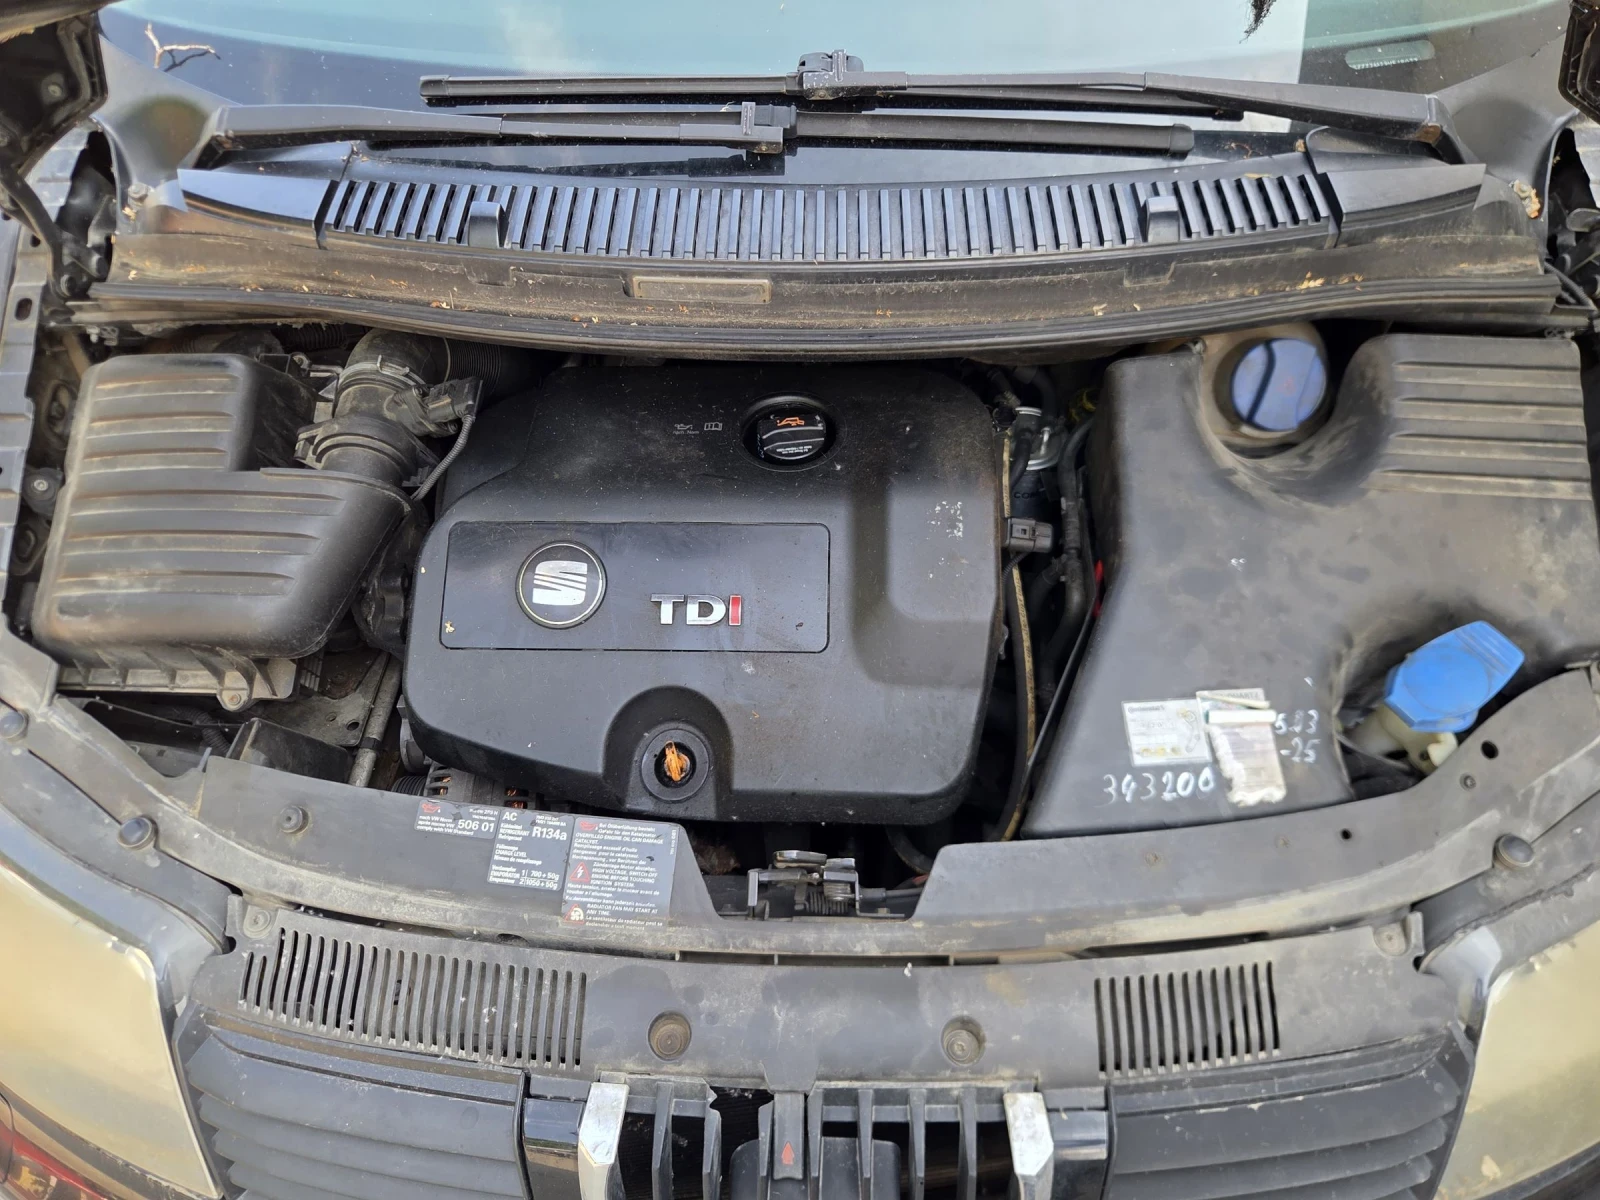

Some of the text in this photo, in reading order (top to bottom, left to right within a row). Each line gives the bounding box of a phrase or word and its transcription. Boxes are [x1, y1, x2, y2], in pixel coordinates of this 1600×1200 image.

[650, 594, 742, 626] TDI
[502, 812, 517, 821] AC
[458, 820, 494, 832] 506 01
[532, 827, 567, 840] R134a
